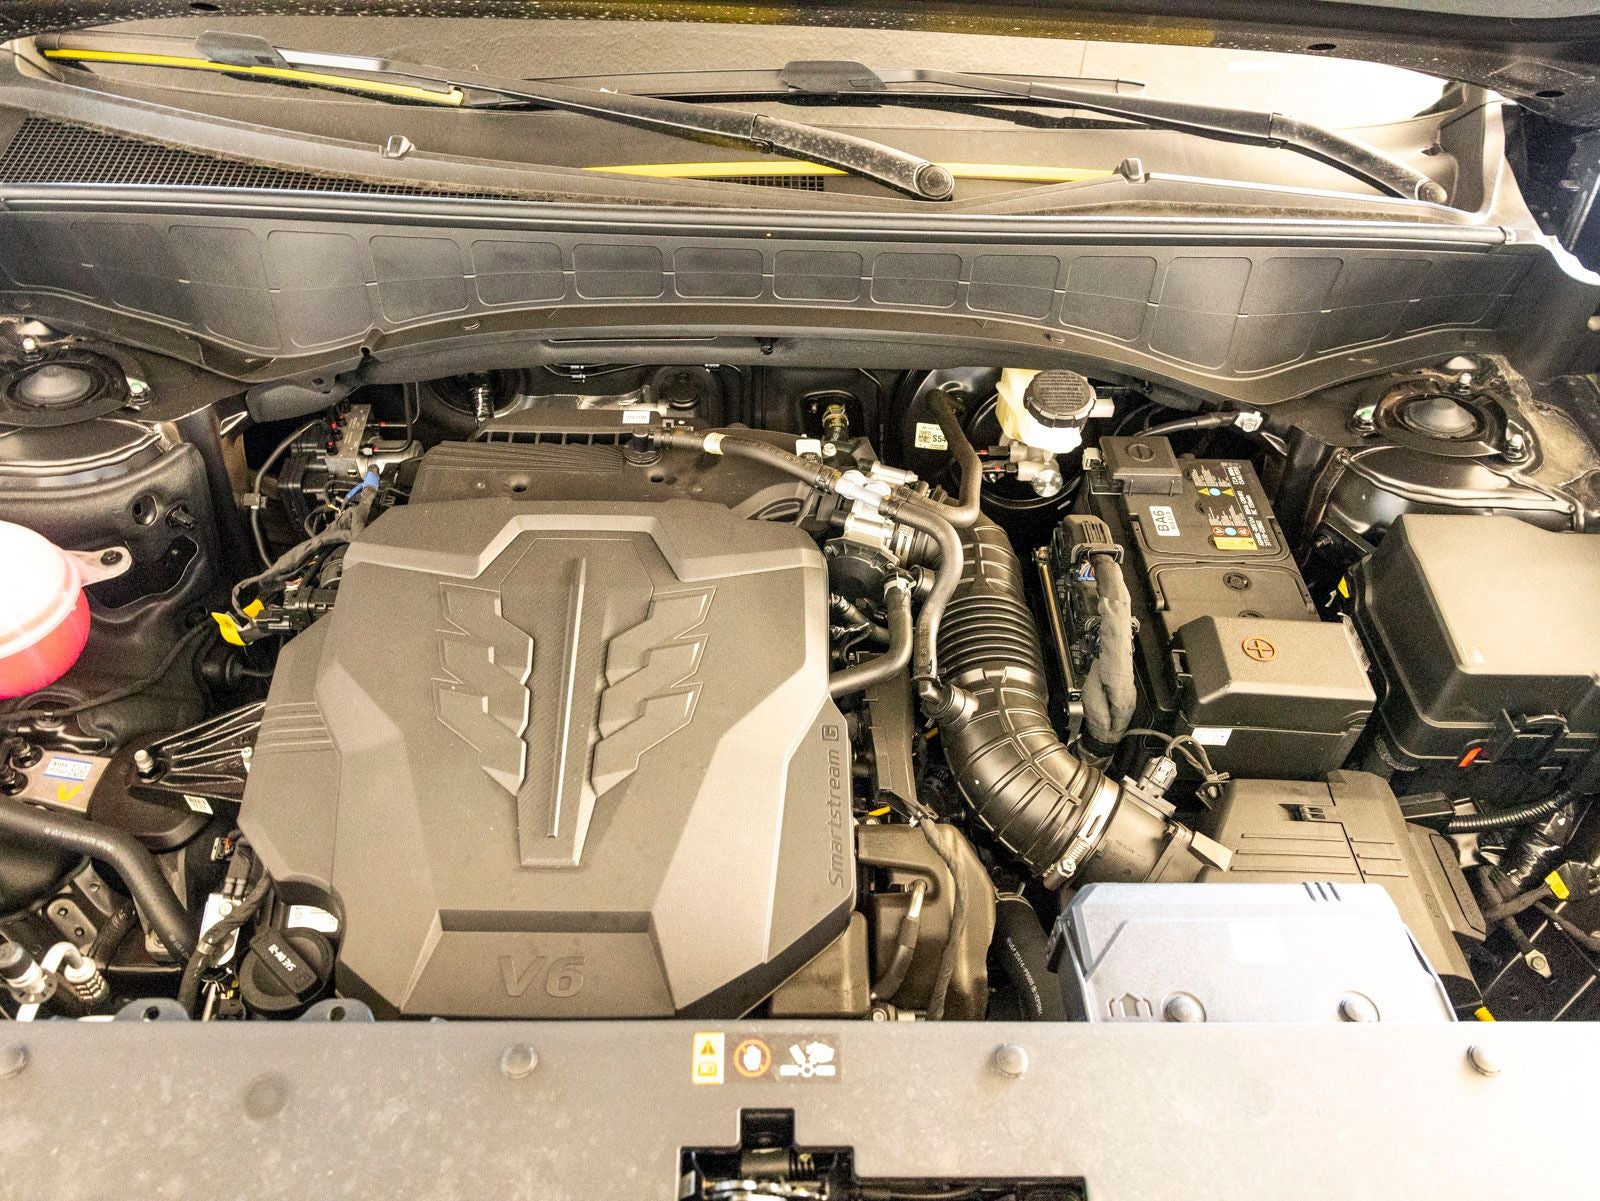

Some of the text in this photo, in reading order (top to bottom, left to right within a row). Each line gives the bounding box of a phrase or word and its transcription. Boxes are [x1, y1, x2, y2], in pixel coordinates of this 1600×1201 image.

[1153, 510, 1170, 532] BA6
[826, 749, 844, 889] Smartstream
[268, 943, 297, 972] SAE 0W-20
[498, 954, 586, 998] V6
